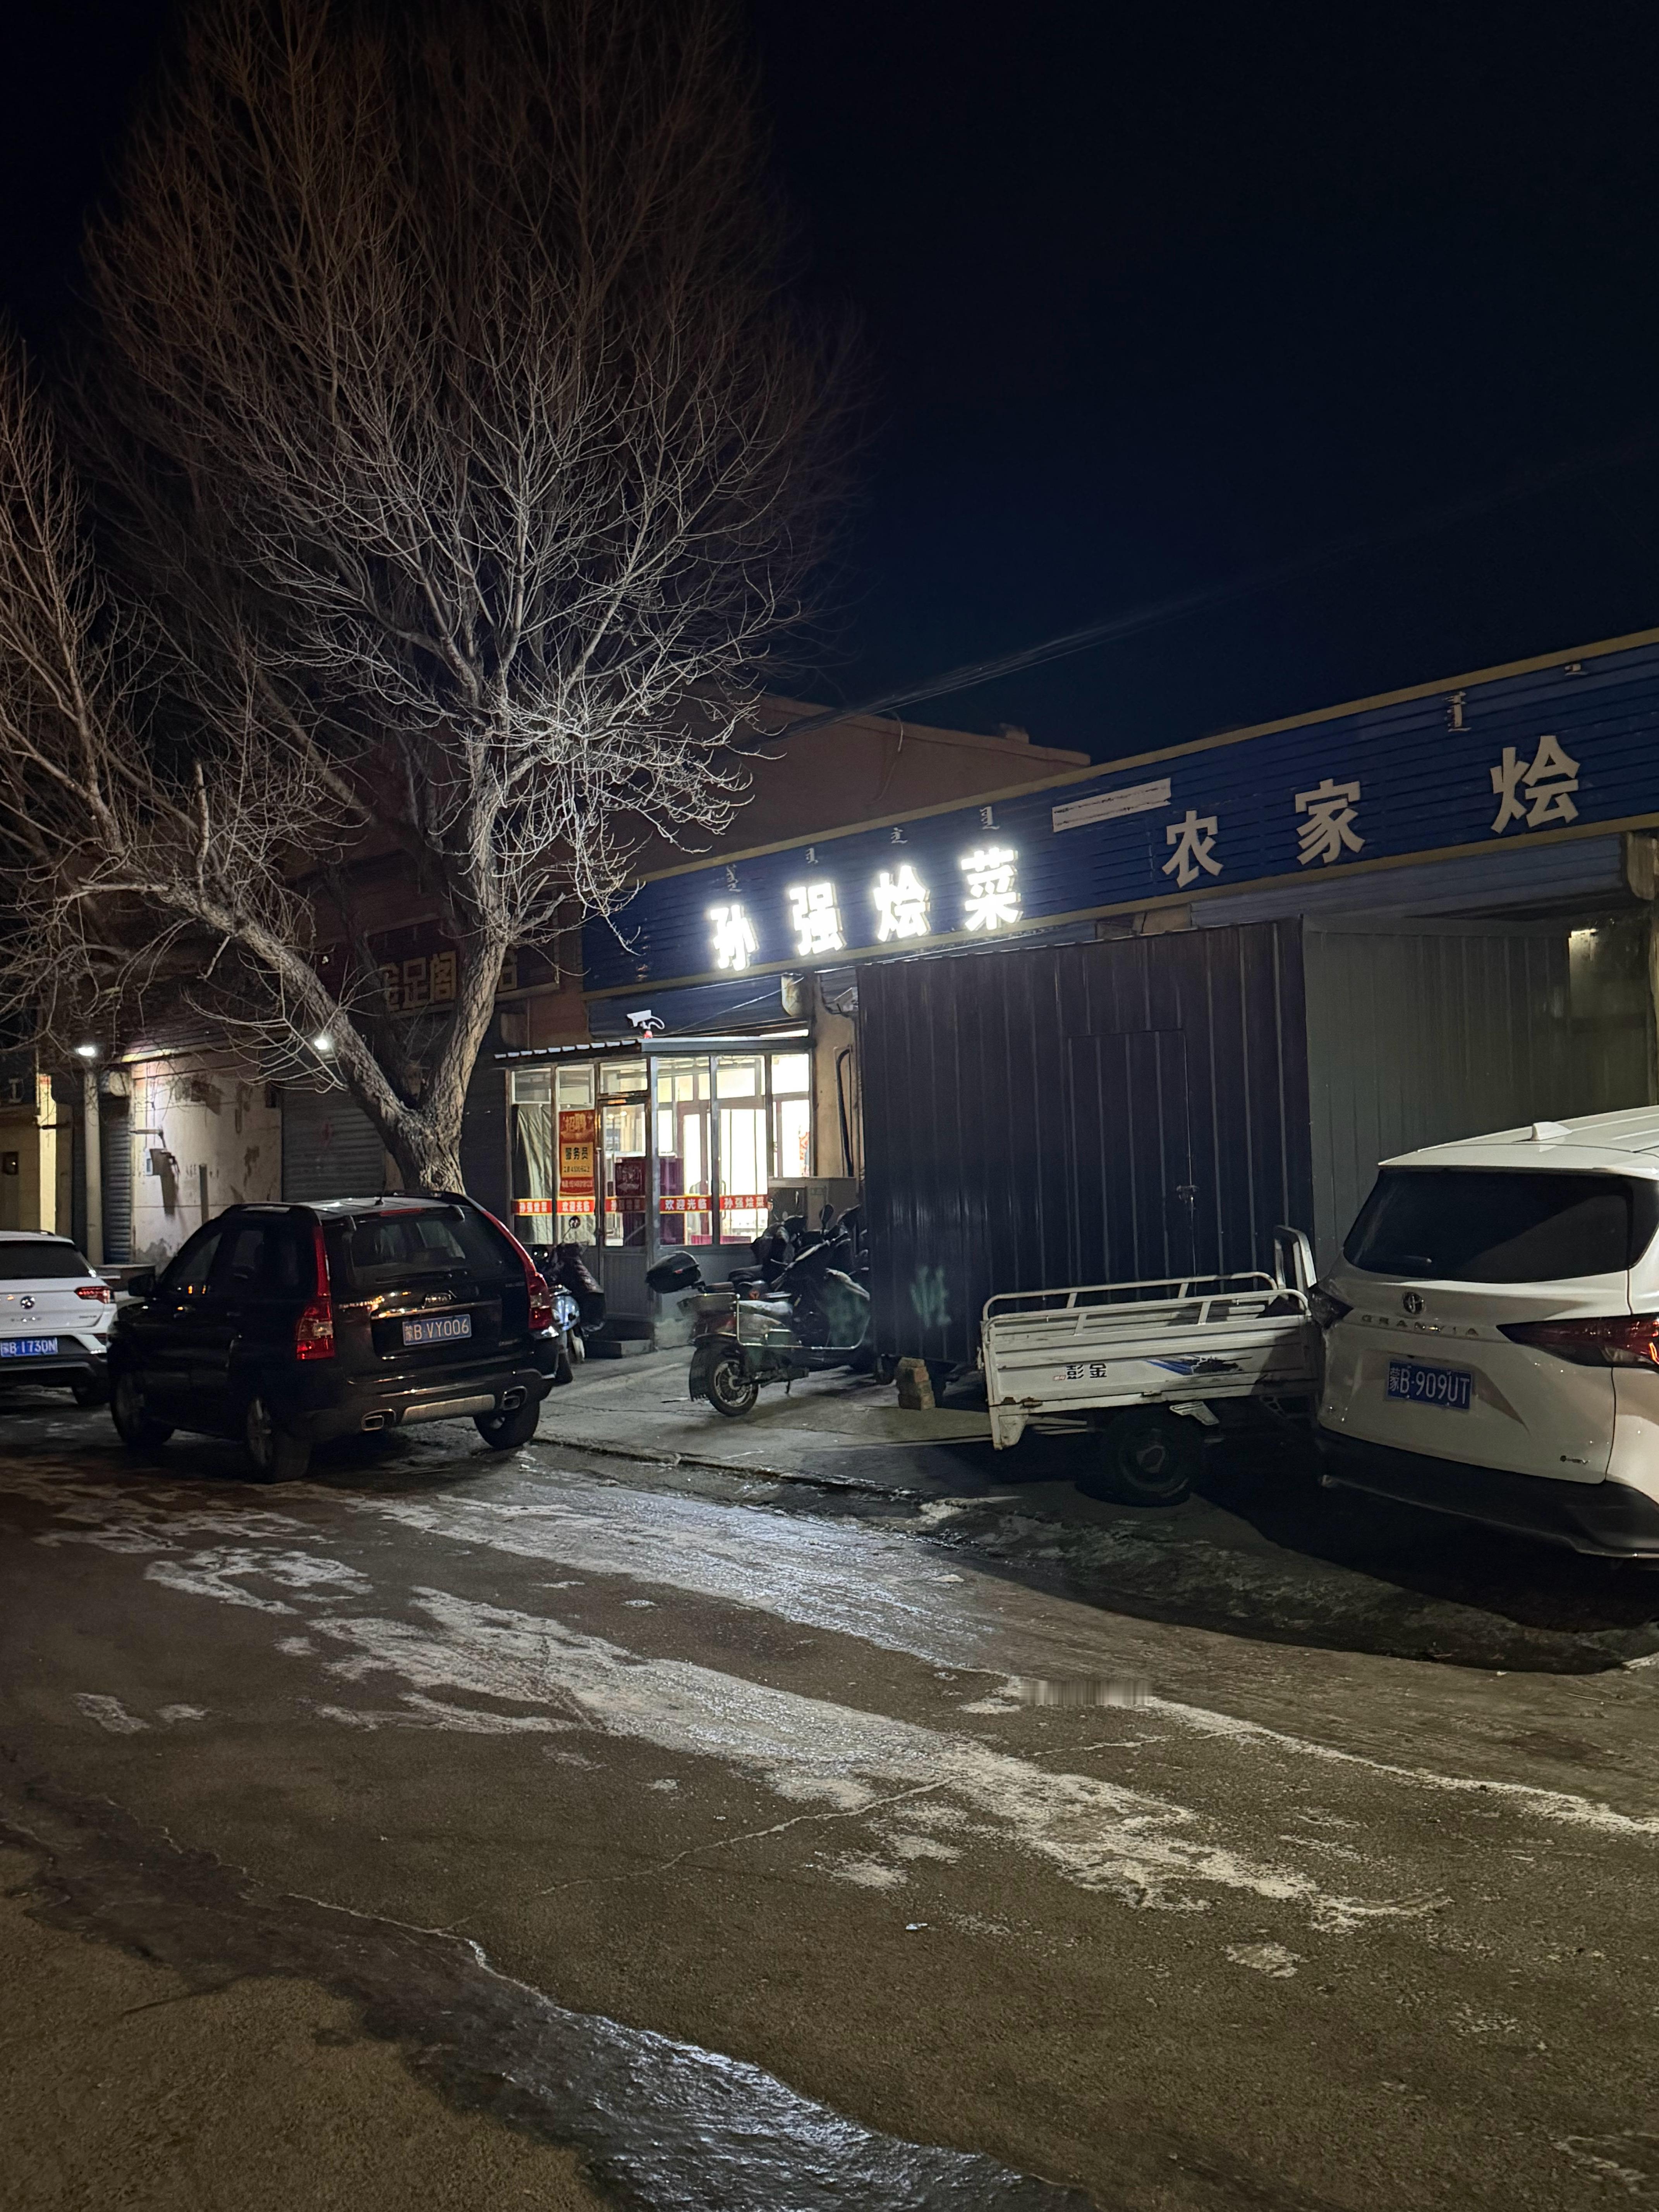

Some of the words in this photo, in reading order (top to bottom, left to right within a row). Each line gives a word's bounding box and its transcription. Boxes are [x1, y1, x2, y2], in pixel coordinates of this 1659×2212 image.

[710, 847, 1024, 971] 孙强烩菜
[565, 1147, 588, 1160] 服务员
[665, 1199, 707, 1211] 欢迎光临
[724, 1196, 765, 1209] 孙强烩菜
